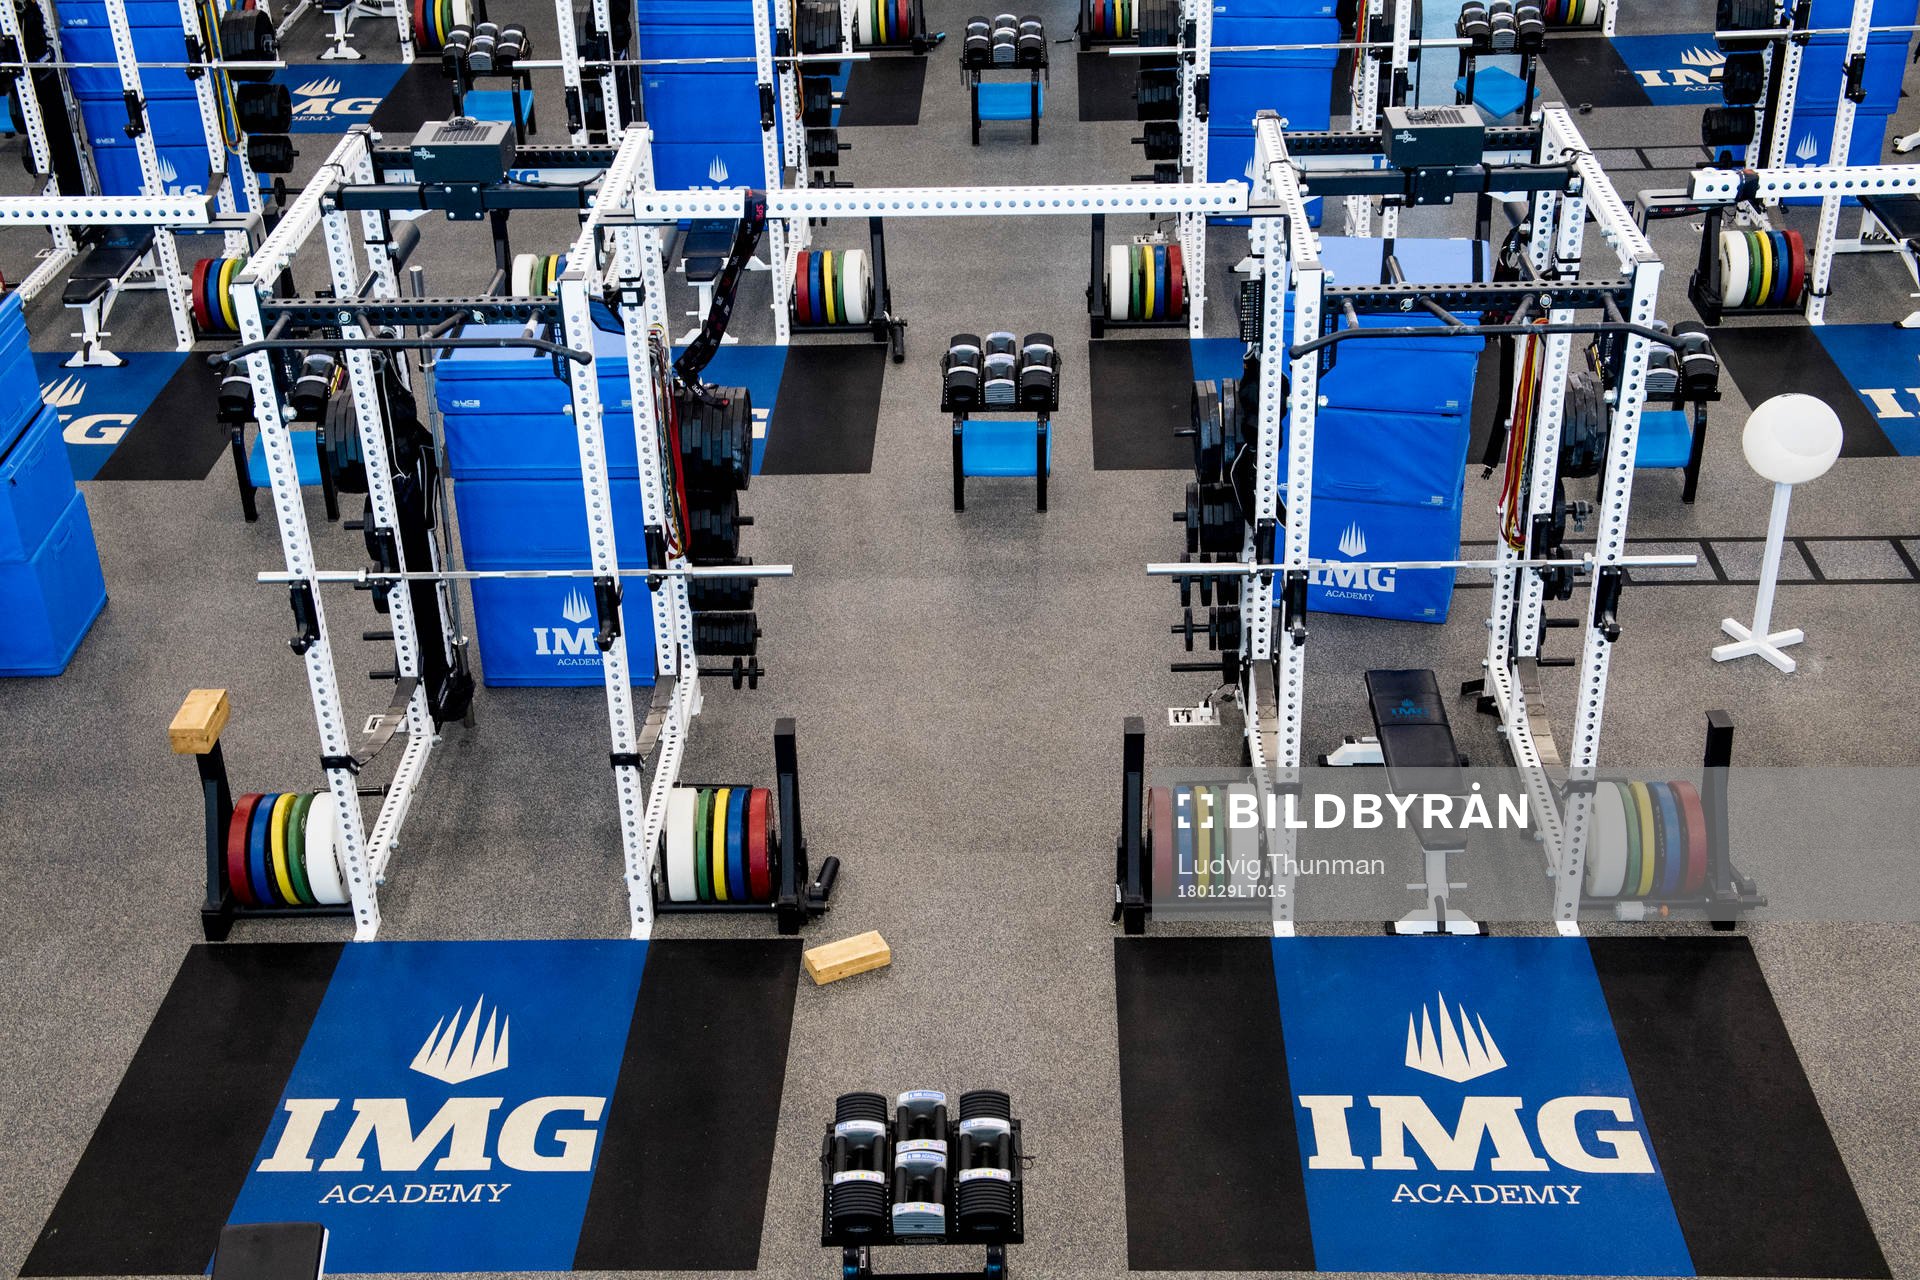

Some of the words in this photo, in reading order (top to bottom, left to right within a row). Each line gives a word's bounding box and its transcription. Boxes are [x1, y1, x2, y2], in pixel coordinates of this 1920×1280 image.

[1634, 67, 1724, 86] IM
[291, 97, 384, 115] MG
[1324, 589, 1375, 602] ACADEMY
[533, 627, 598, 656] IM
[255, 1095, 607, 1172] IMG
[1298, 1095, 1656, 1174] IMG
[318, 1183, 512, 1204] ACADEMY
[1391, 1183, 1582, 1205] ACADEMY
